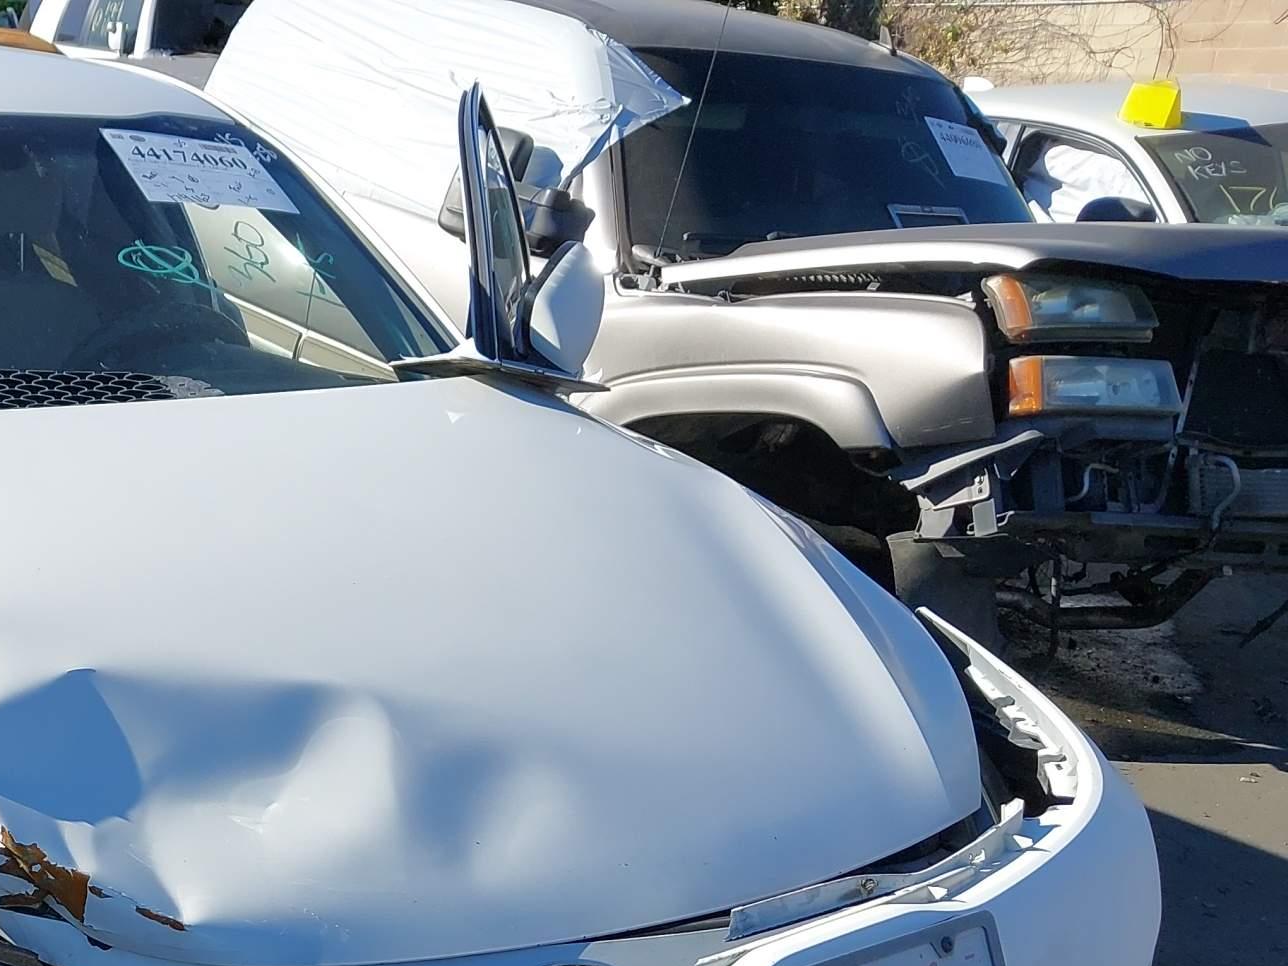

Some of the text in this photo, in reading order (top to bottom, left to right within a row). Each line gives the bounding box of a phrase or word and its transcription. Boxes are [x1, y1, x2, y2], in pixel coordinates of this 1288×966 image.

[132, 145, 248, 170] 44174060
[1174, 146, 1212, 163] NO
[1187, 160, 1247, 180] KEYS
